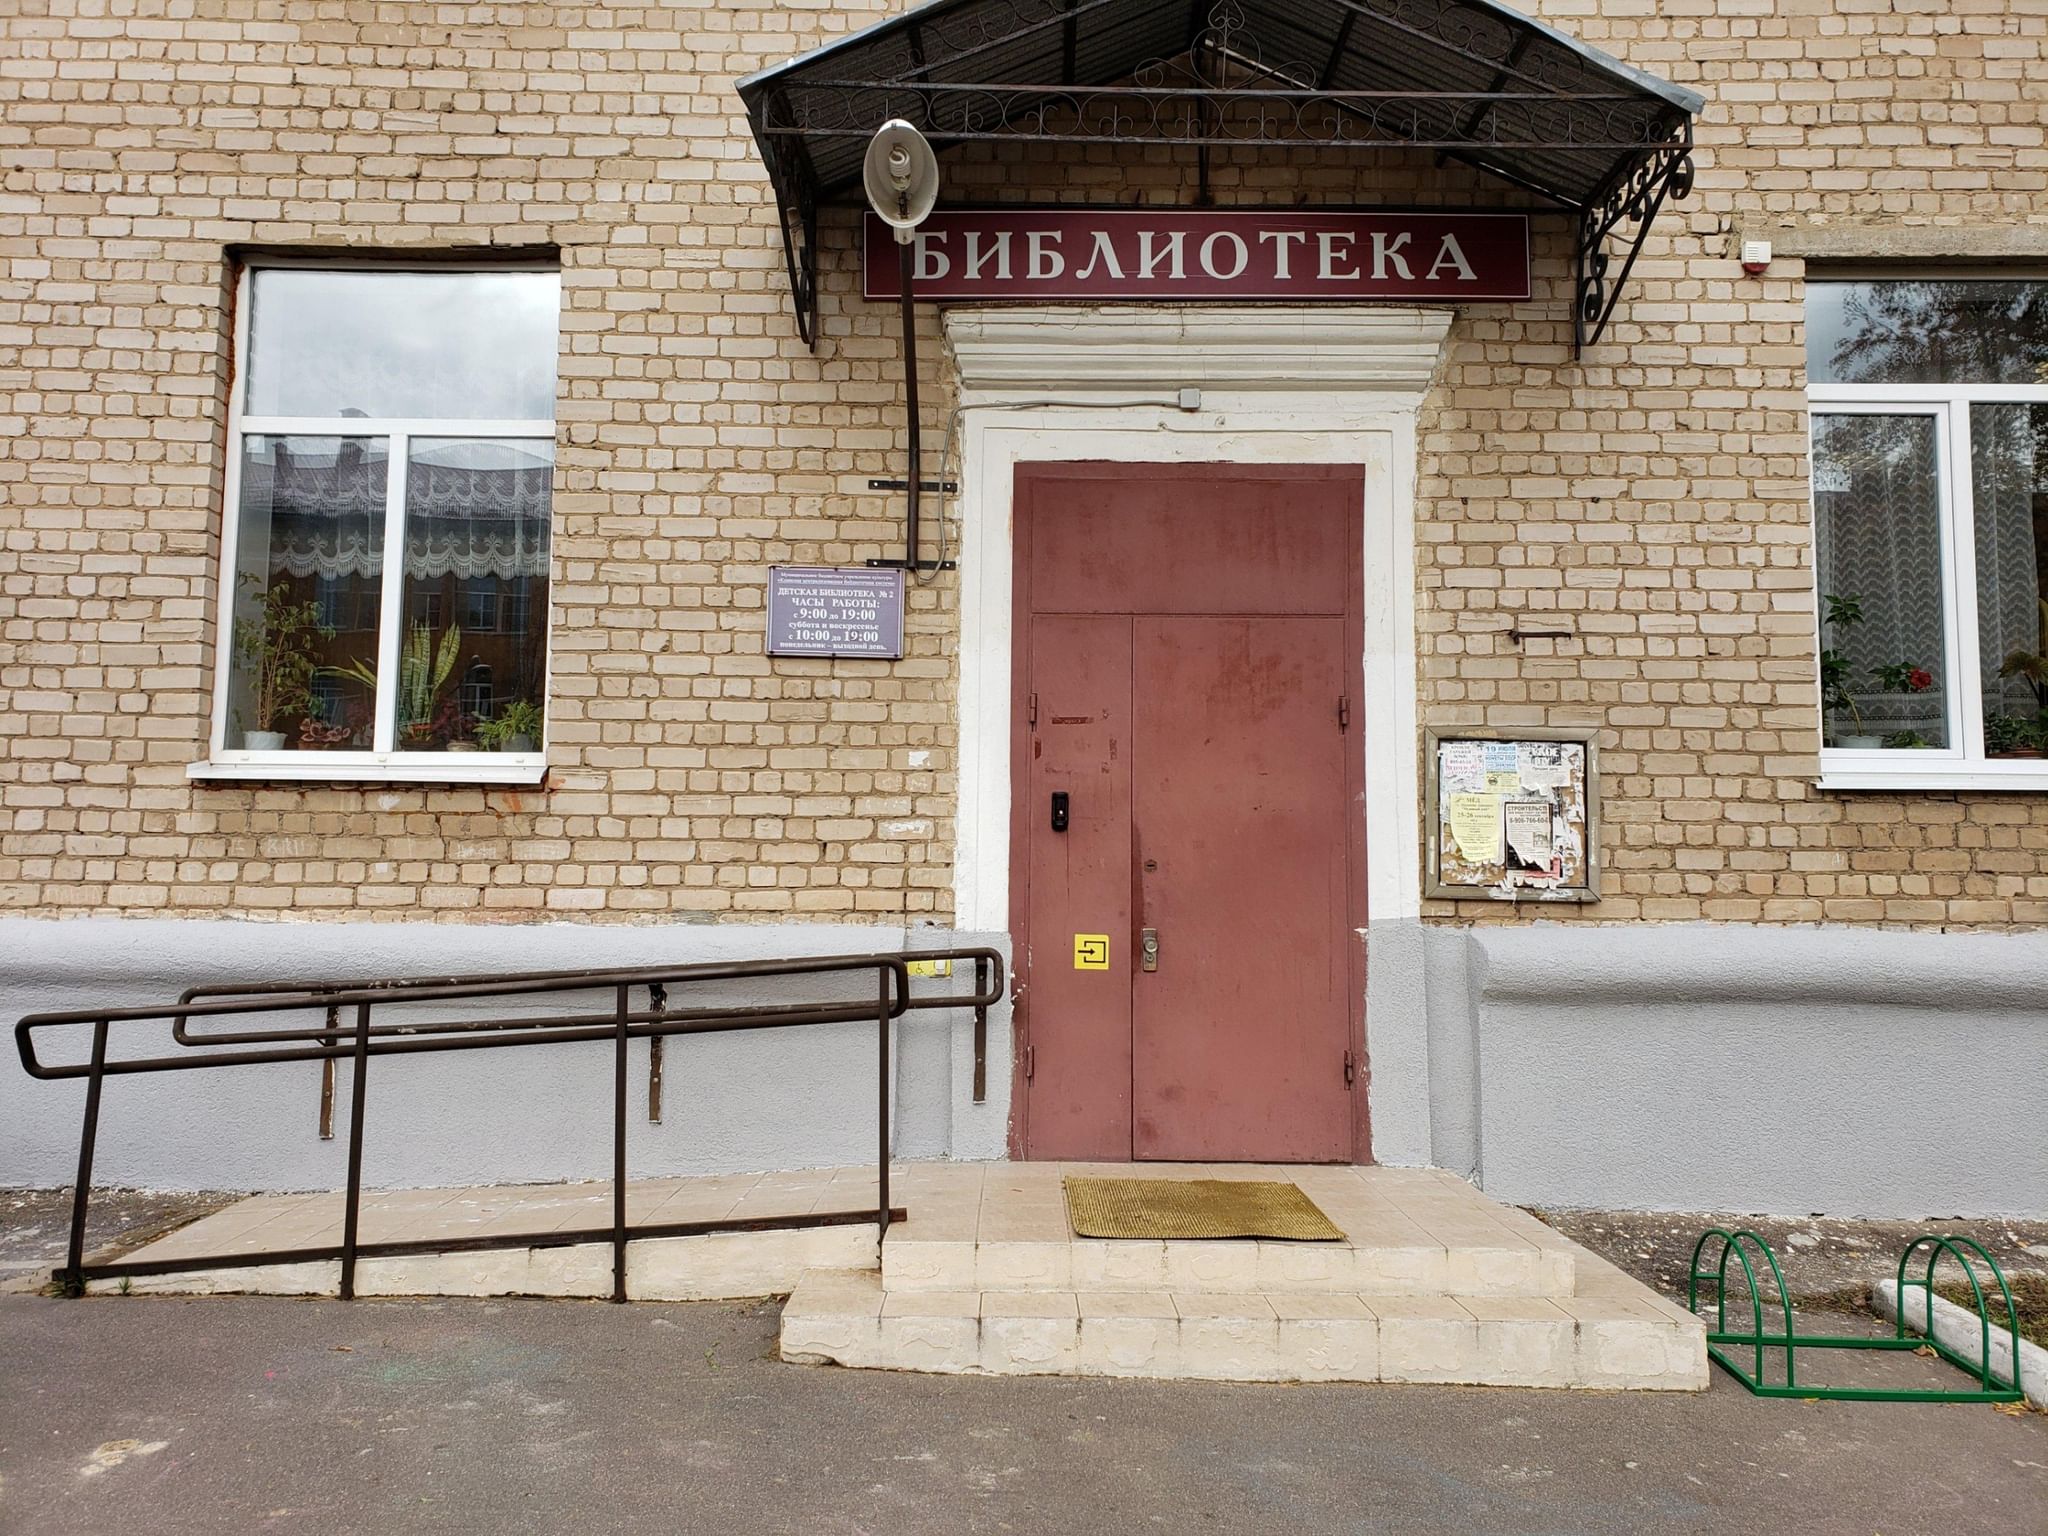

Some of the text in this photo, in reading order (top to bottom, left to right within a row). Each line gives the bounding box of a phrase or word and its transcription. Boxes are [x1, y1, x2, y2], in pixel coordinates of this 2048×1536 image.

[911, 231, 1478, 281] БИБЛИОТЕКА
[778, 588, 817, 596] ДЕТСКАЯ
[820, 589, 875, 598] БИБЛИОТЕКА
[792, 598, 880, 608] ЧАСЫ РАБОТЫ:
[800, 609, 827, 619] 9:00
[842, 609, 875, 620] 19:00
[829, 623, 879, 631] воскресенье
[796, 630, 829, 640] 10:00
[845, 631, 878, 642] 19:00
